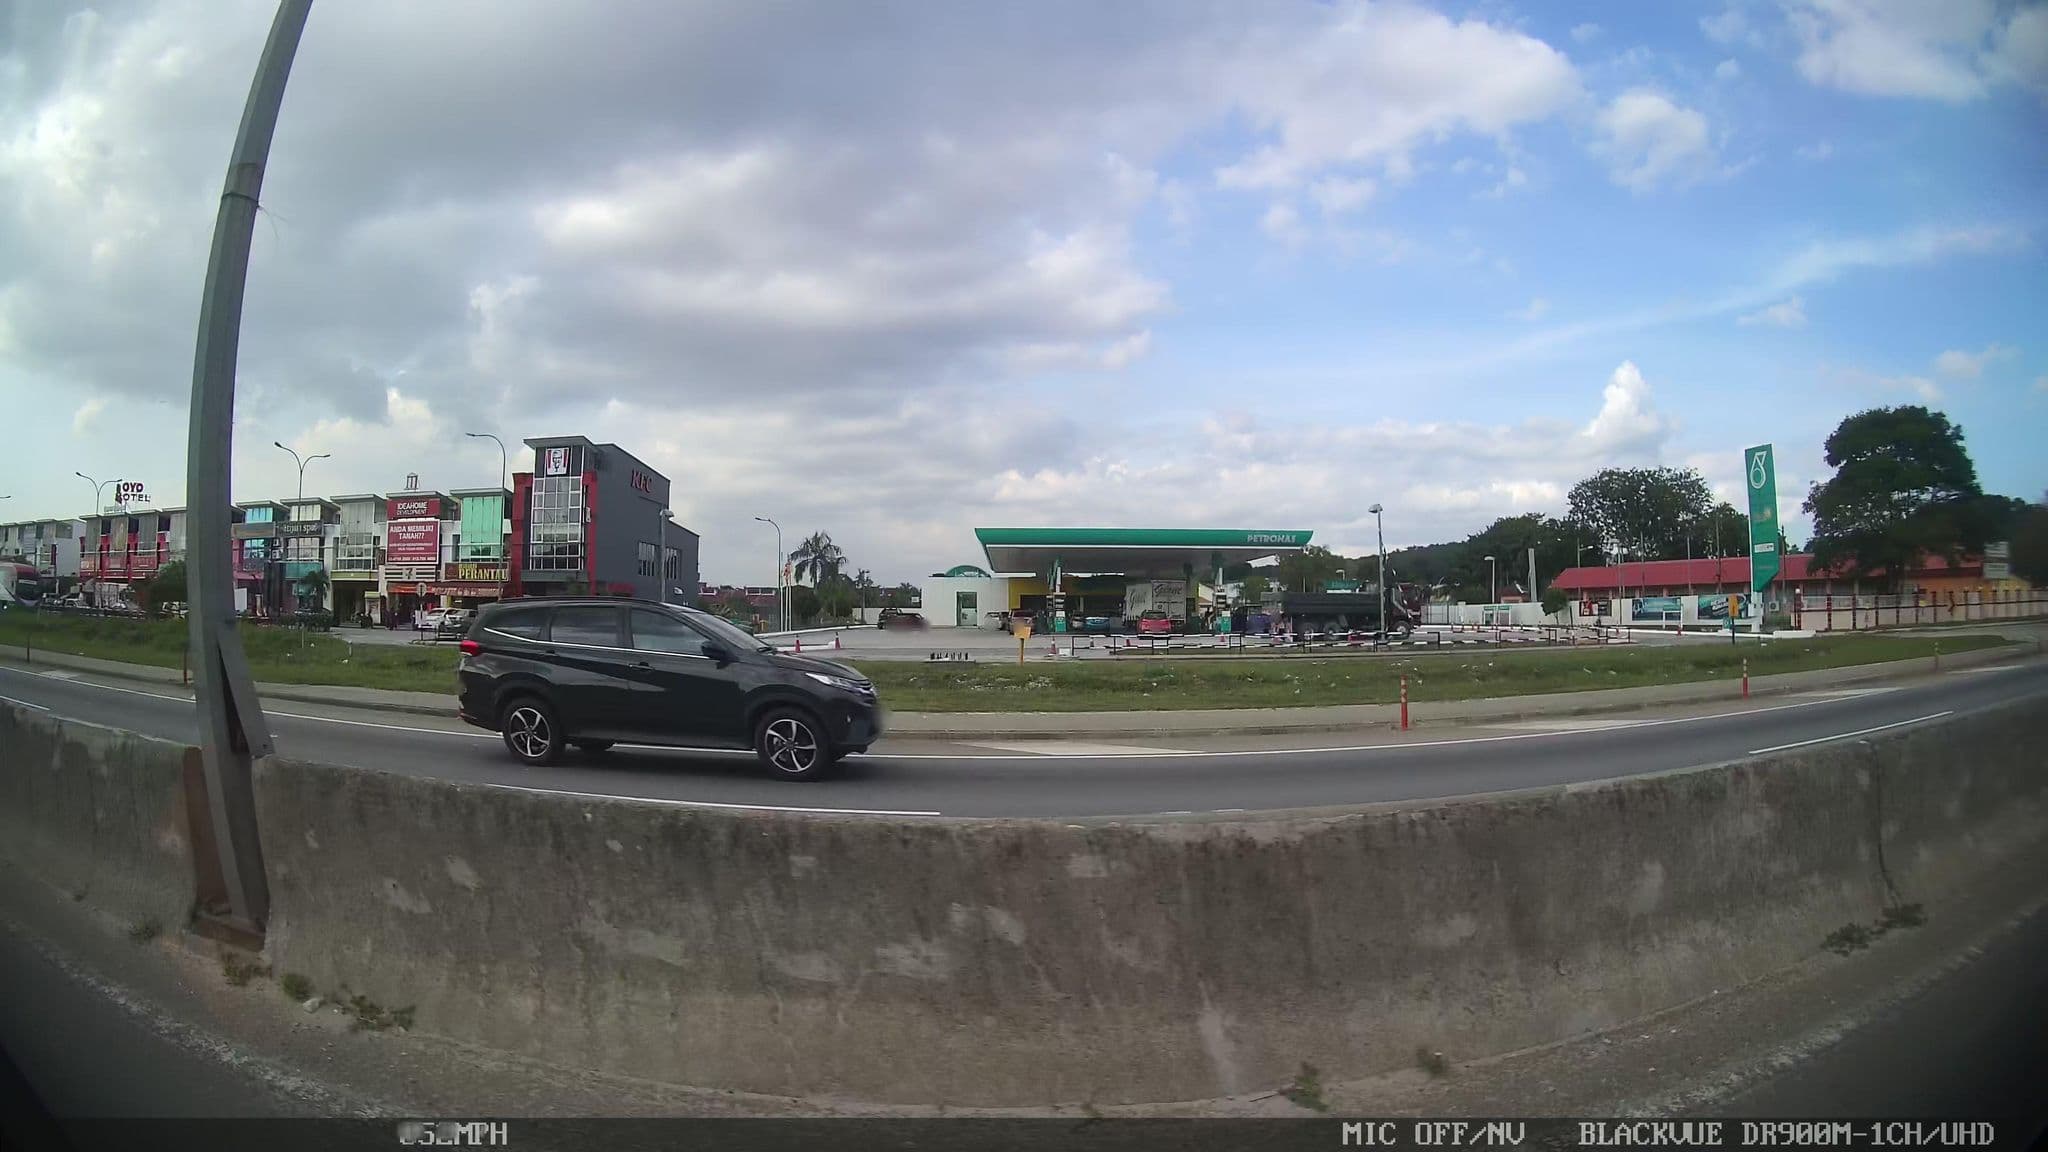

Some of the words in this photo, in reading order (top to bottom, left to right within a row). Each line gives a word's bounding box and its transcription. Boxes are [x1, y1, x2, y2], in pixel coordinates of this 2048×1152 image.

[631, 470, 652, 493] KFC
[123, 482, 144, 493] OYO
[397, 502, 428, 510] IDEAHOME
[1247, 534, 1297, 543] PETRONAS
